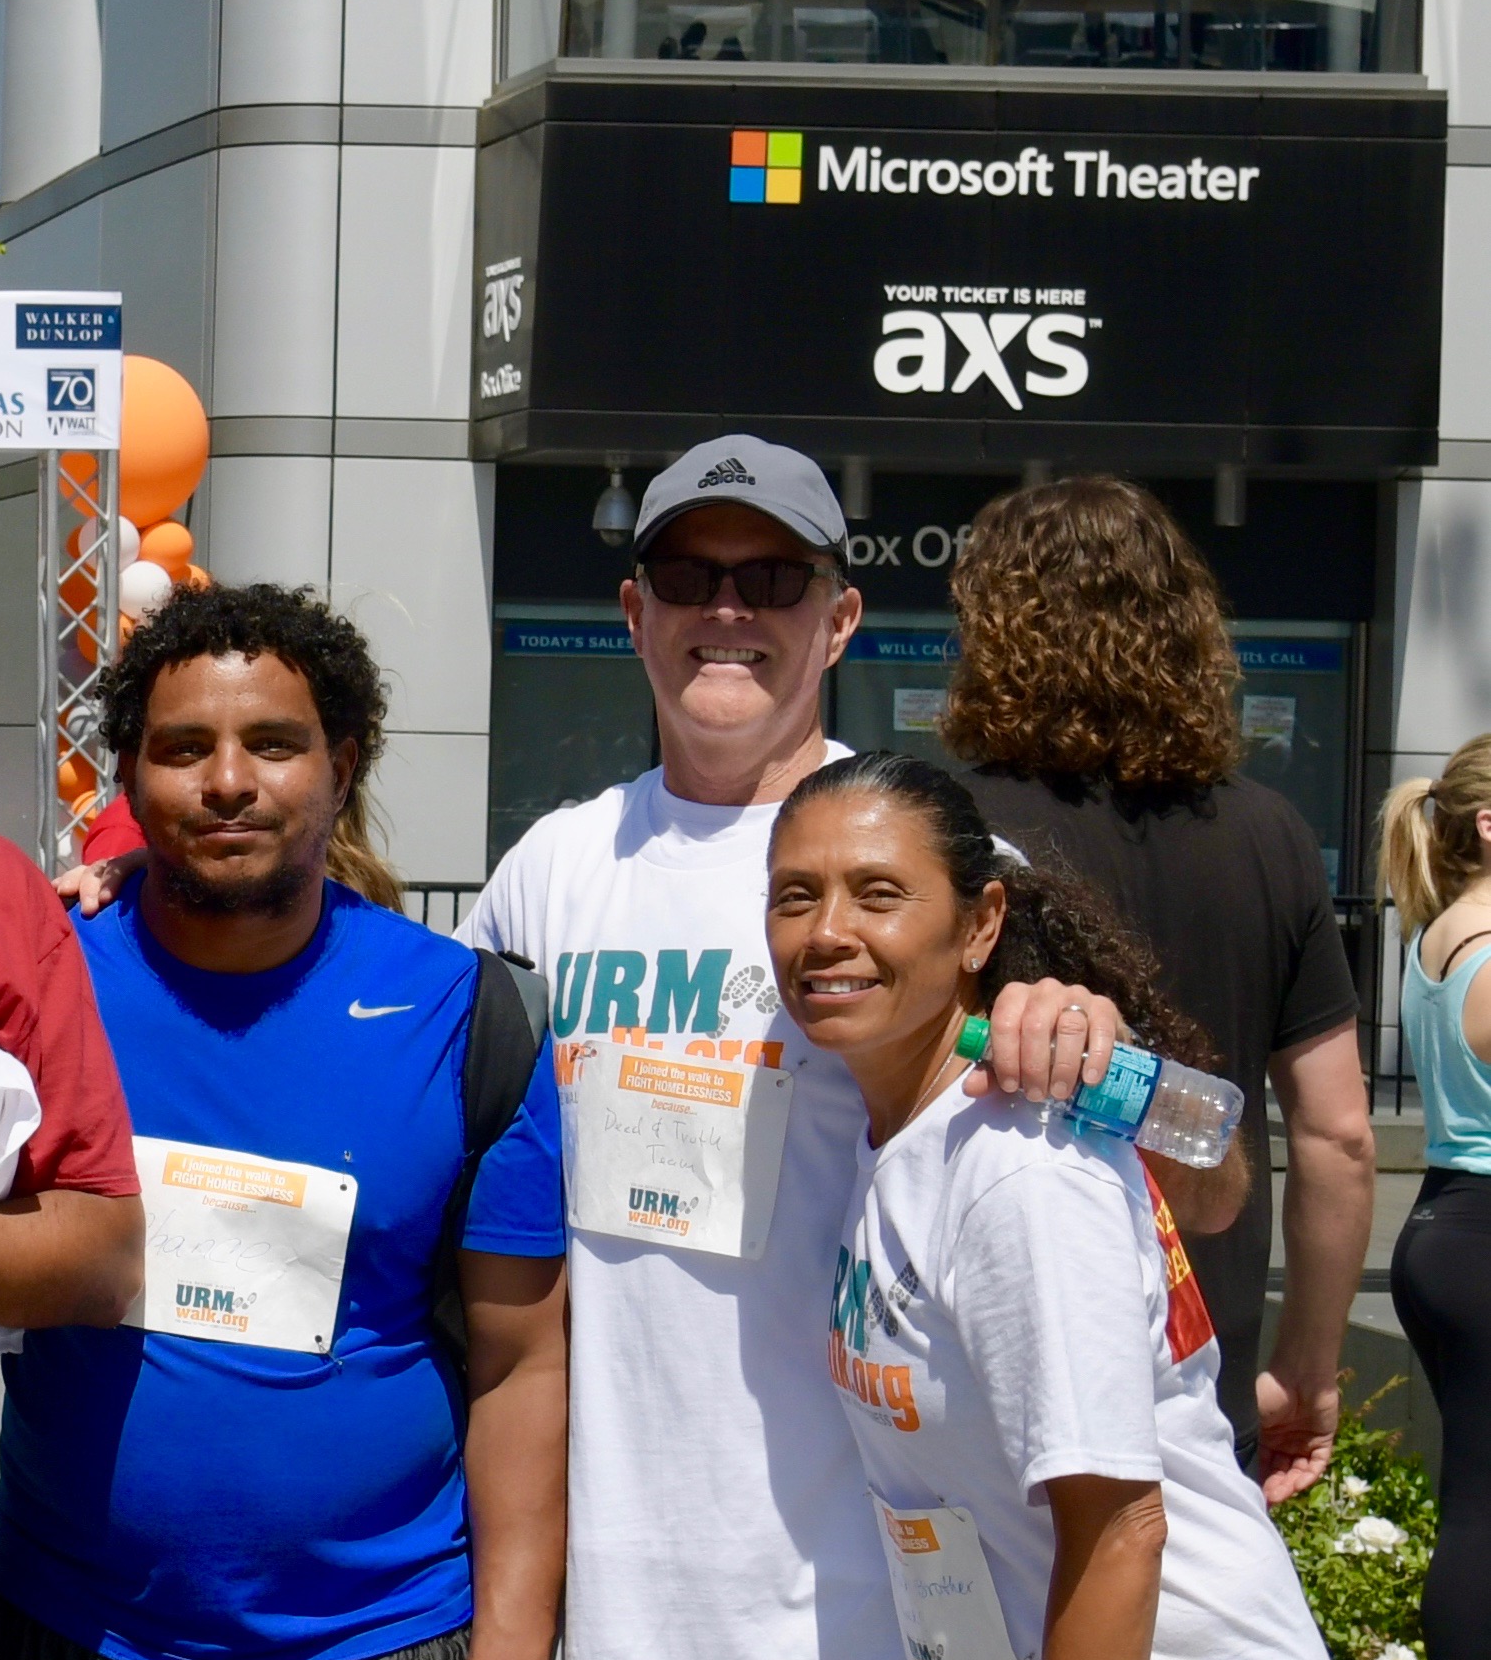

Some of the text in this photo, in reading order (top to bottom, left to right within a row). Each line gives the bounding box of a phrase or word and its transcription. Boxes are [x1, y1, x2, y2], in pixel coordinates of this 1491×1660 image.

[818, 146, 1260, 201] Microsoft Theater
[884, 285, 1086, 306] YOUR TICKET IS HERE
[25, 312, 103, 325] WALKER
[26, 328, 103, 341] DUNLOP
[873, 310, 1090, 411] axs
[51, 376, 93, 406] 70
[697, 472, 756, 489] adidas
[519, 635, 584, 648] TODAY'S
[879, 643, 916, 655] WILL
[1270, 653, 1306, 664] CALL
[553, 948, 733, 1038] URM
[634, 1061, 724, 1087] I joined the walk to
[625, 1076, 732, 1103] FIGHT HOMELESSNESS
[182, 1158, 286, 1185] I joined the walk to
[172, 1171, 295, 1203] FIGHT HOMELESSNESS
[628, 1187, 681, 1217] URM
[628, 1210, 691, 1237] walk.org
[175, 1283, 235, 1313] URM
[175, 1306, 249, 1333] walk.org
